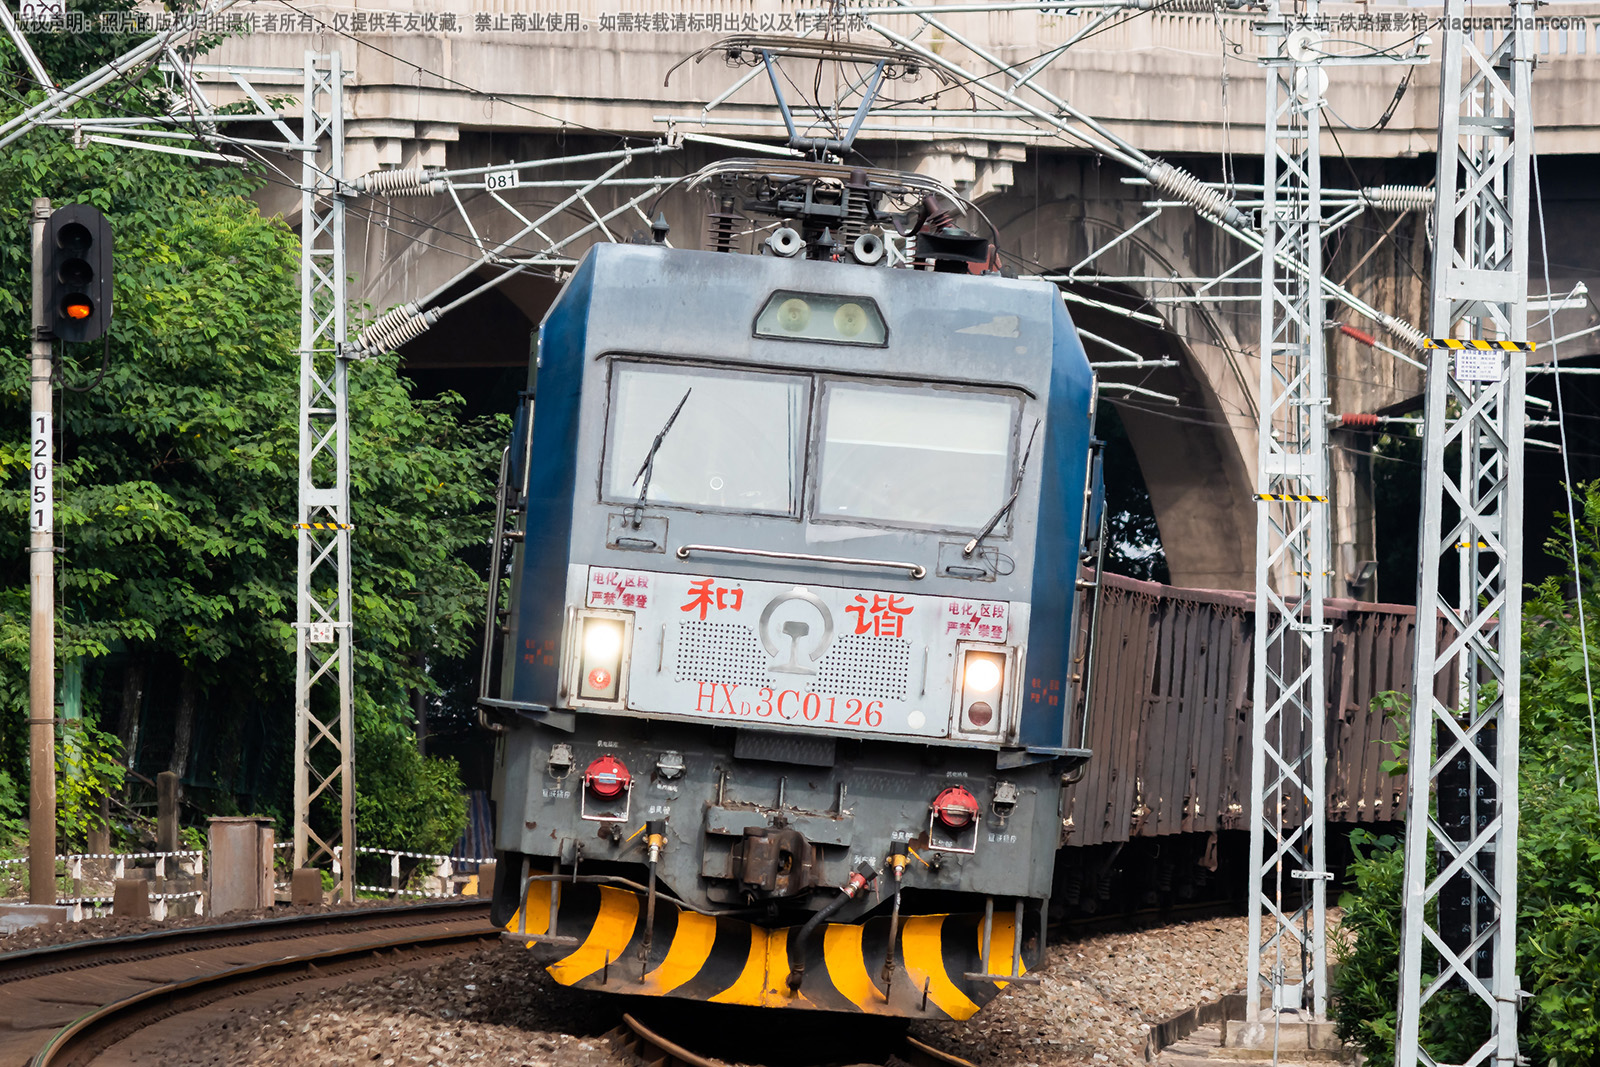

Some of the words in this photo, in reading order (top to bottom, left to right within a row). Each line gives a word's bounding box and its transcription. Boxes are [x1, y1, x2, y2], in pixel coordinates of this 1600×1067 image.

[487, 174, 515, 189] 081
[34, 417, 47, 526] 12051
[593, 571, 649, 588] 电化区段
[590, 591, 648, 608] 严禁攀登
[681, 578, 744, 621] 和
[844, 593, 914, 638] 谐
[949, 602, 1005, 618] 电化区段
[946, 621, 1003, 639] 严禁攀登
[695, 681, 884, 727] HXD3C0126
